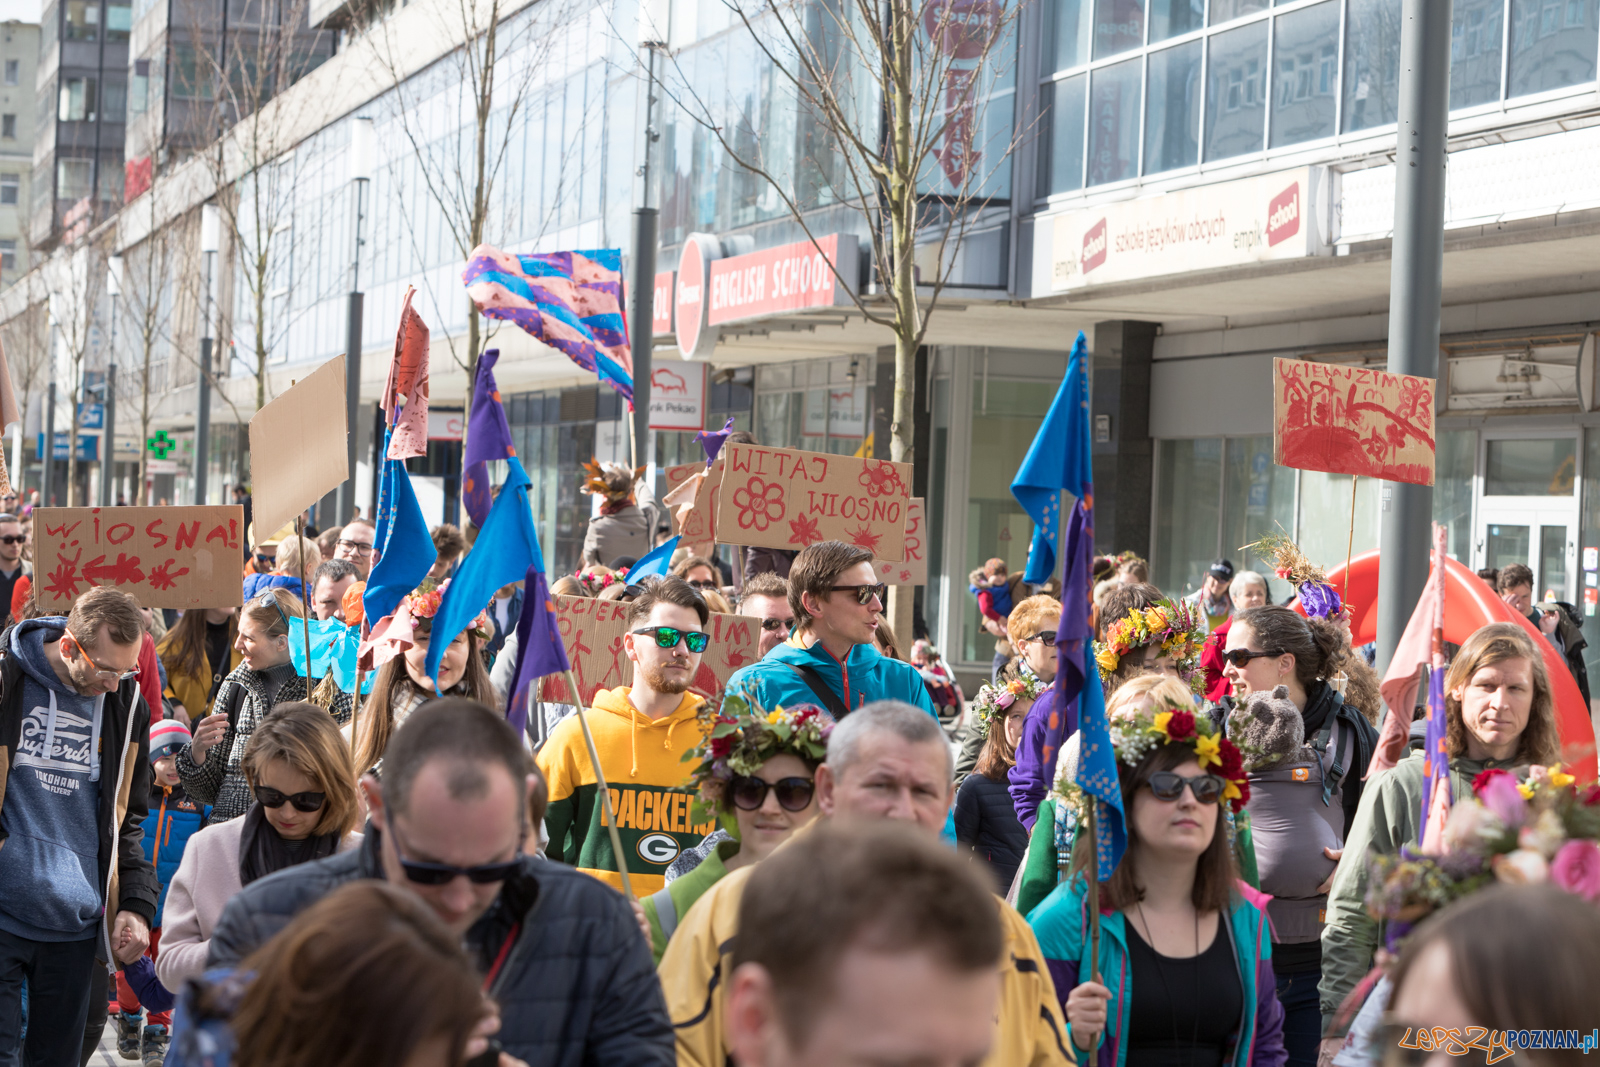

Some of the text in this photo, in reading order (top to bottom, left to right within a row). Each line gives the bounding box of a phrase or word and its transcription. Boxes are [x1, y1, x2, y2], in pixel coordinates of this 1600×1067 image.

[1188, 208, 1225, 244] obcych
[1233, 193, 1298, 252] empik school
[1083, 227, 1105, 261] school
[712, 252, 831, 310] ENGLISH SCHOOL
[1279, 360, 1352, 380] UCIEKAJ
[666, 402, 697, 414] Pekao
[732, 448, 828, 483] WITAJ
[808, 490, 900, 524] WIOSNO
[556, 597, 627, 621] UCIEK
[35, 769, 80, 790] YOKOHAMA
[639, 834, 678, 862] G
